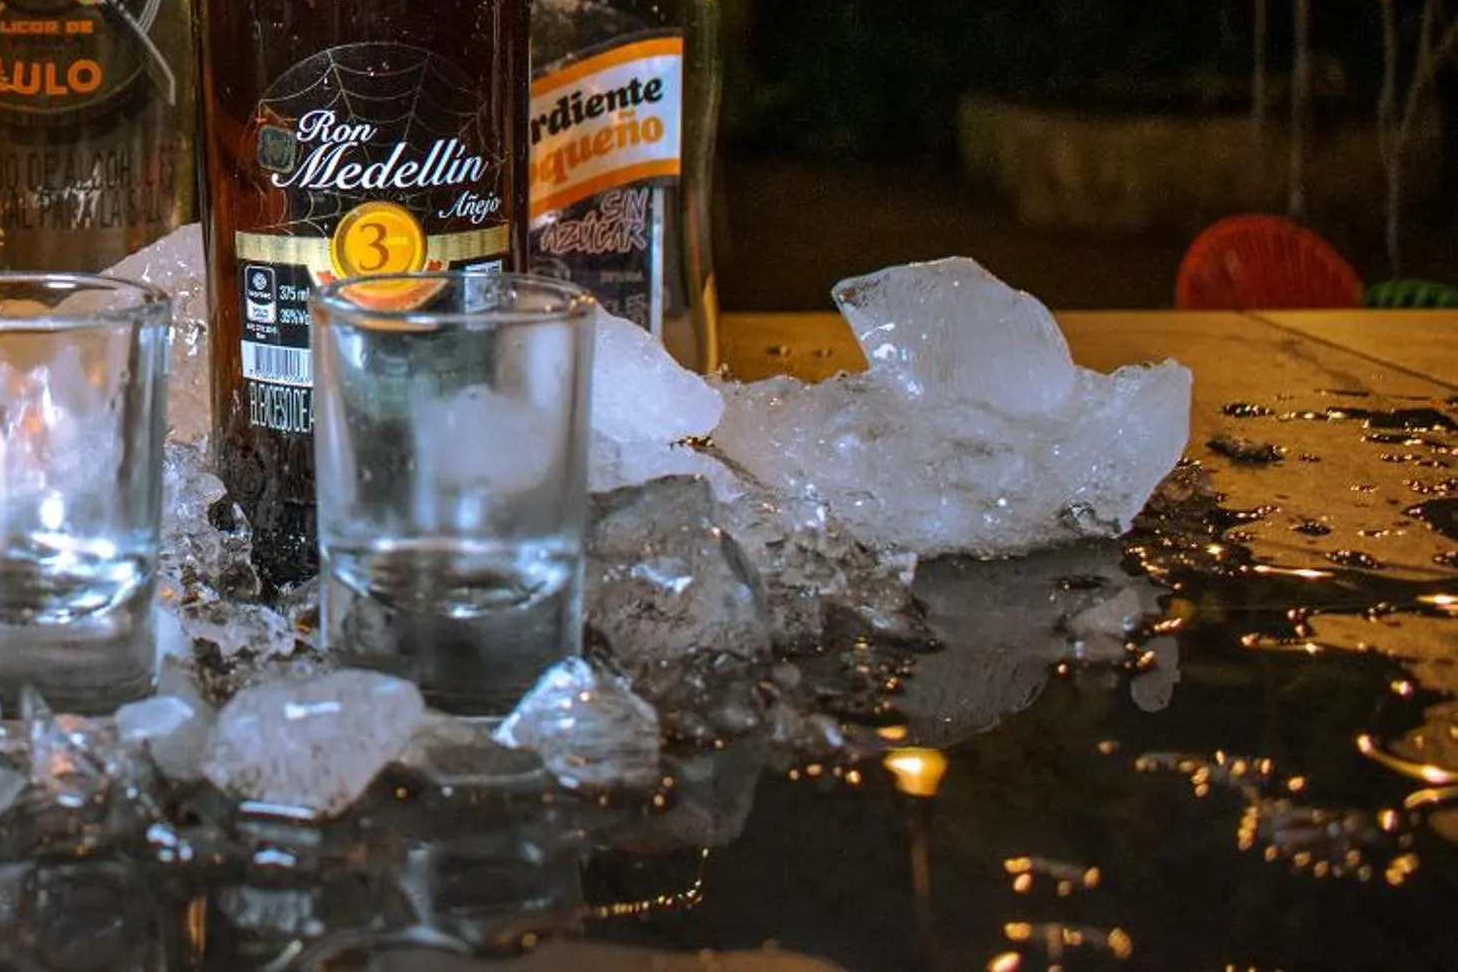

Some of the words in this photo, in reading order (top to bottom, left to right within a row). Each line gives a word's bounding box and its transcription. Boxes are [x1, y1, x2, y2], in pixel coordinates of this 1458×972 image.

[296, 110, 378, 143] Ron
[530, 76, 664, 146] rdiente
[528, 109, 664, 186] queño
[438, 190, 503, 225] Añejo
[358, 222, 390, 271] 3
